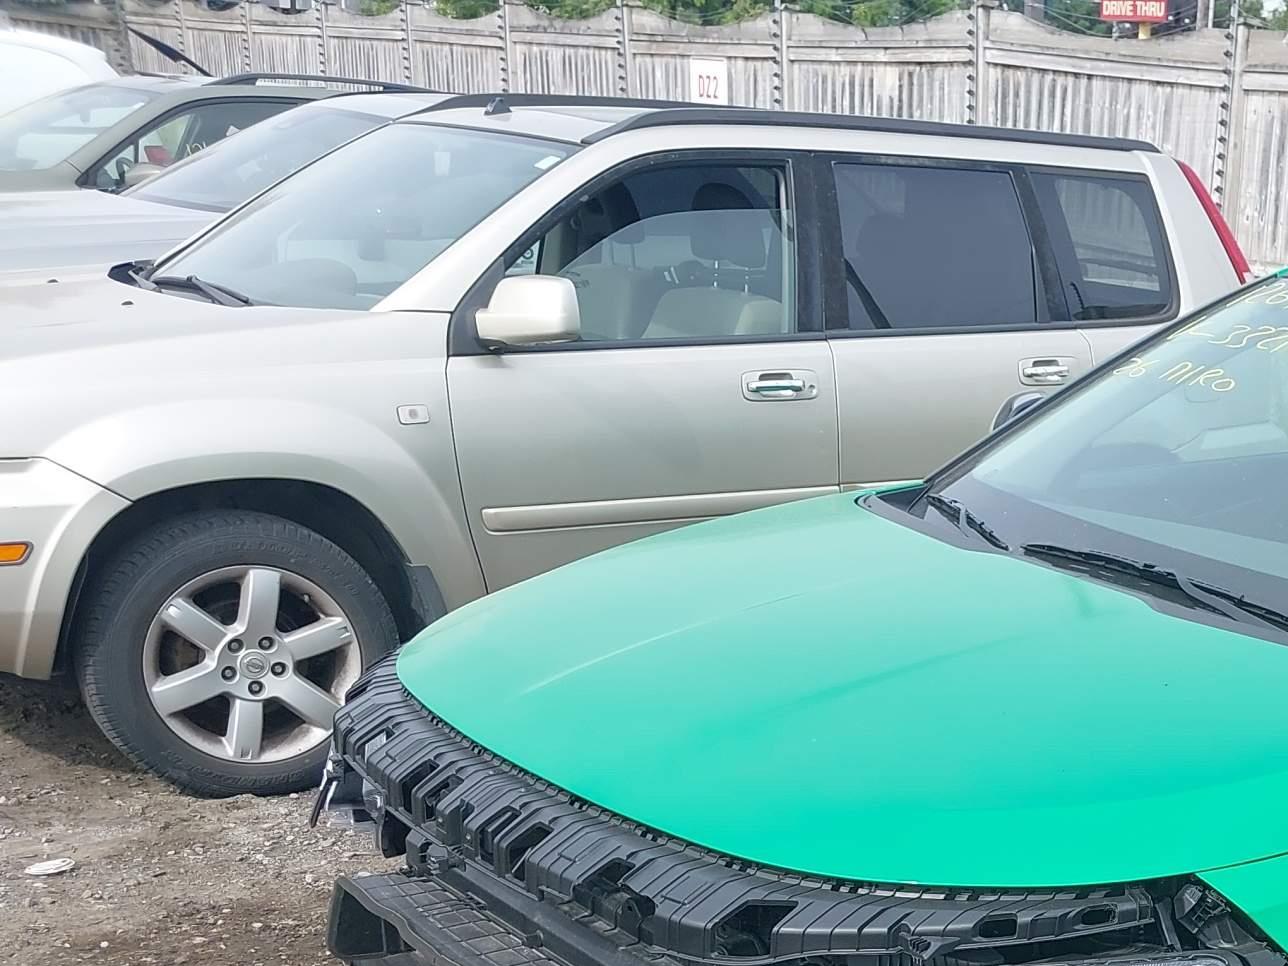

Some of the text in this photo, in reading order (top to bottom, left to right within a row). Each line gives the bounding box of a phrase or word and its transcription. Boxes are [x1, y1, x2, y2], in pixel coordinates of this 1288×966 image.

[1102, 1, 1165, 17] DRIVE THRU
[1158, 361, 1236, 392] NIRO
